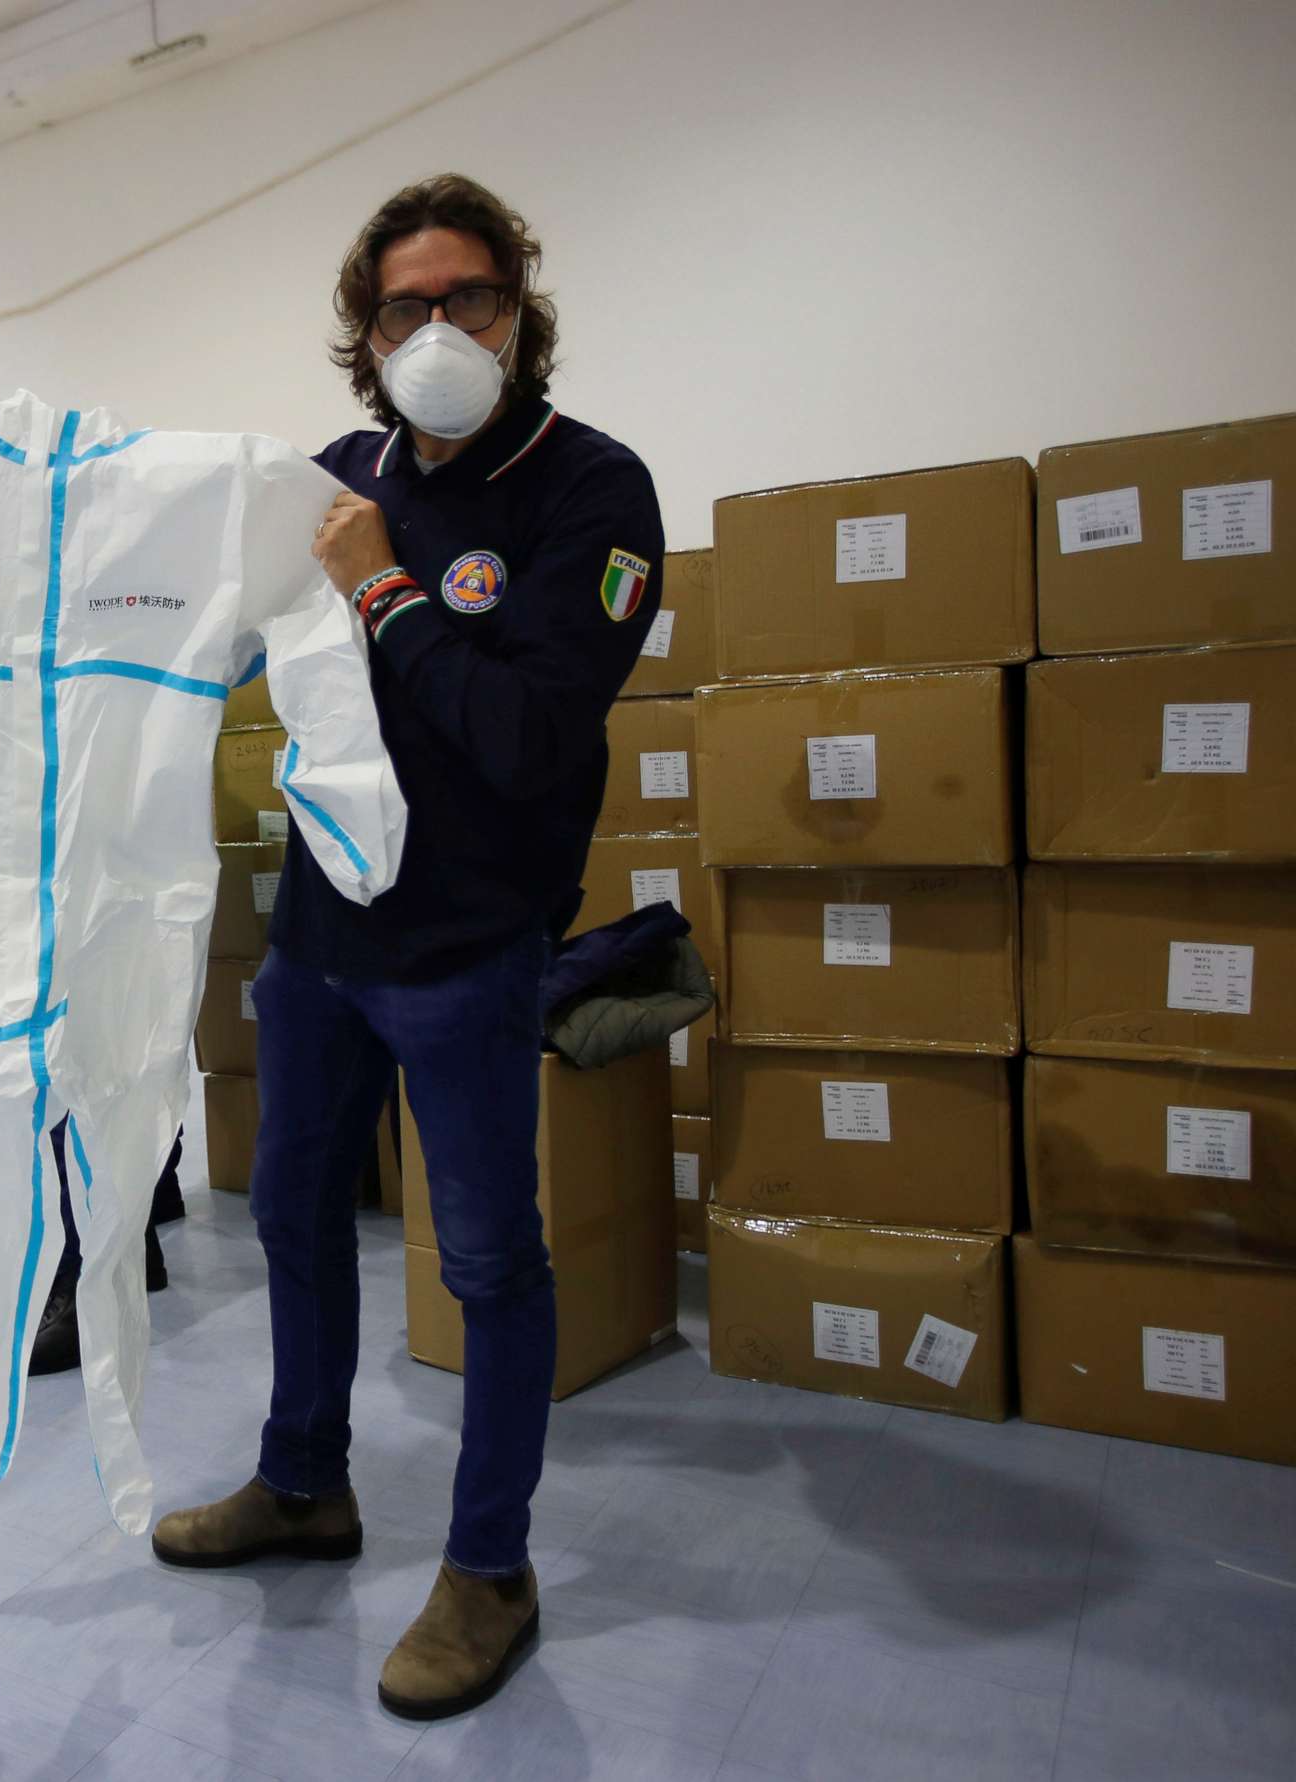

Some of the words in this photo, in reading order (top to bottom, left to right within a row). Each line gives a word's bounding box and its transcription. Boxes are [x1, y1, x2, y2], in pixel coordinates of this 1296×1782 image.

[454, 555, 492, 571] Protezione
[491, 561, 503, 582] Civile
[615, 554, 646, 575] ITALIA
[139, 595, 185, 610] 埃沃防护
[446, 583, 467, 609] REGIONE
[468, 595, 497, 609] PUGLIA
